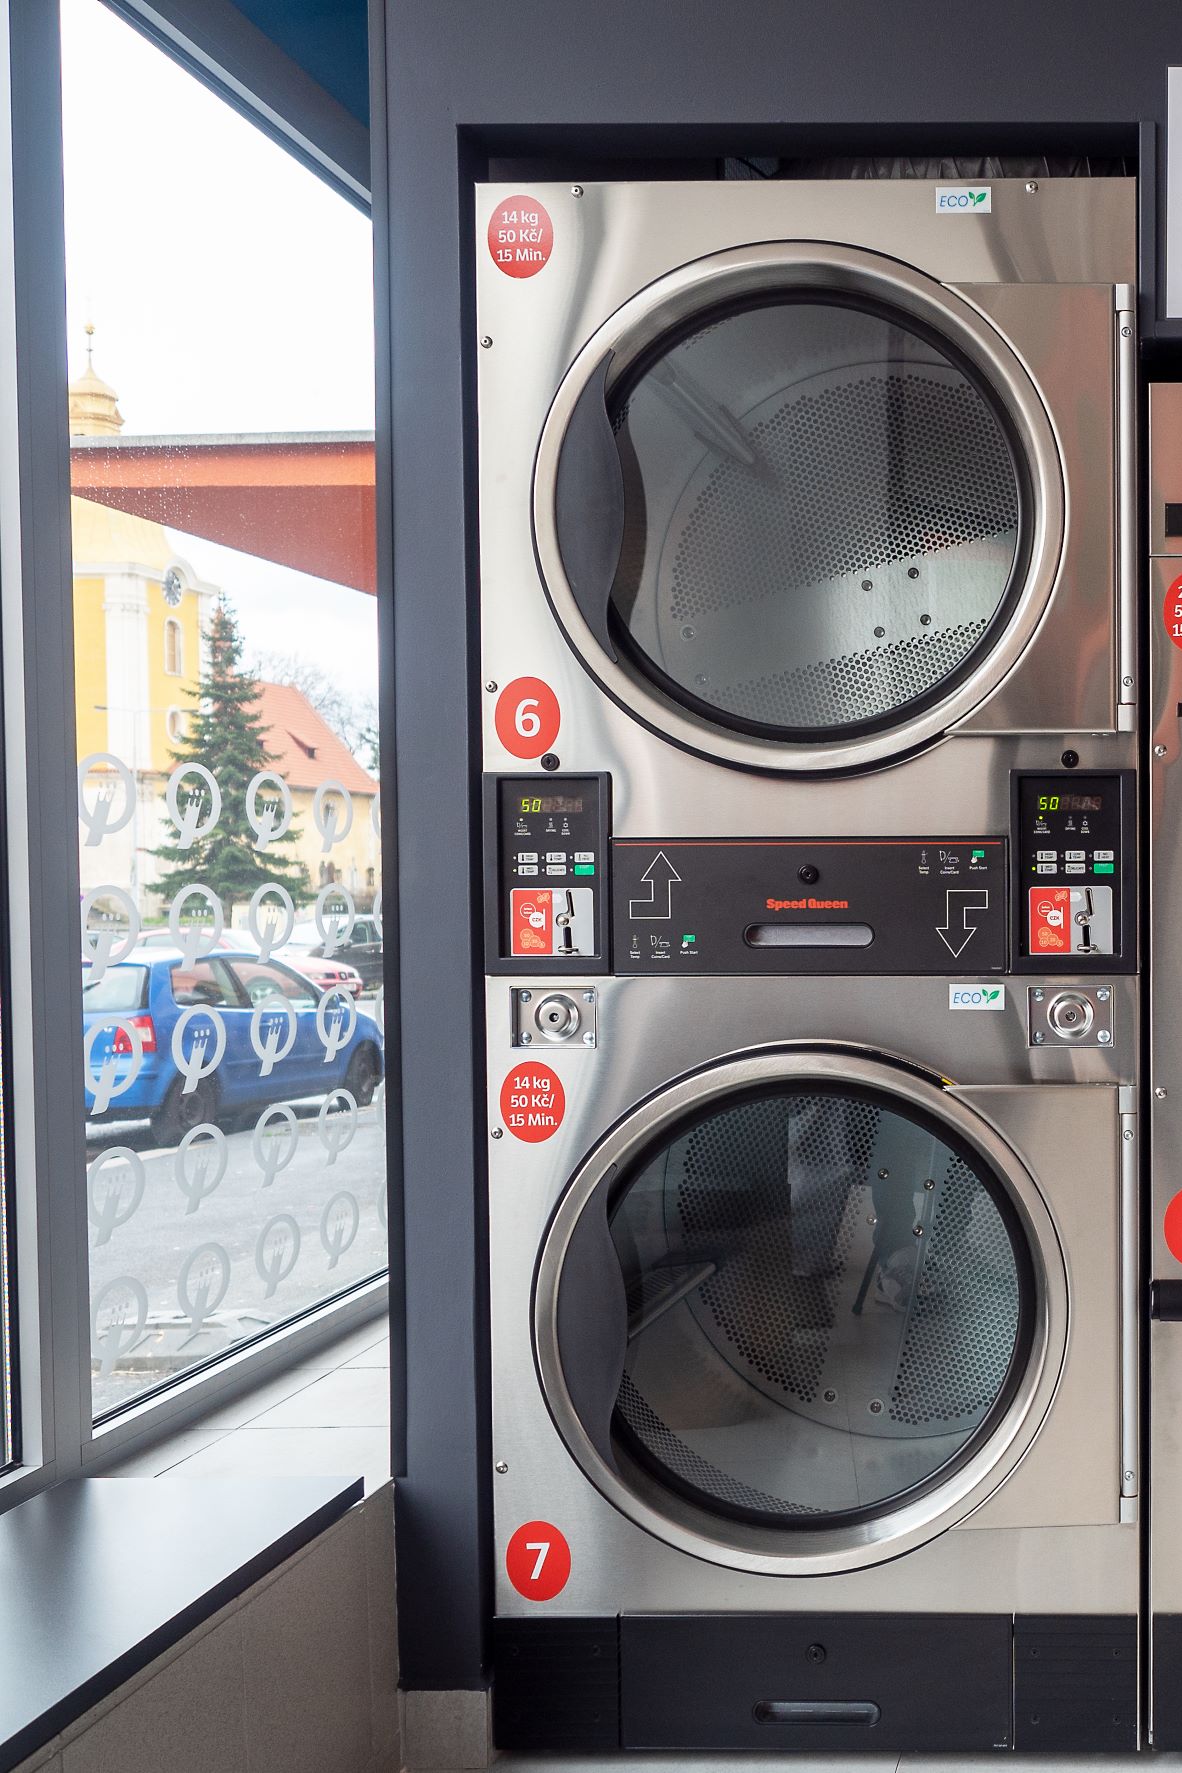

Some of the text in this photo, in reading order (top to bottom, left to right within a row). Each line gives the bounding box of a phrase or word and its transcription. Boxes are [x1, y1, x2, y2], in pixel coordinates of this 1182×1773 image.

[939, 194, 968, 208] ECO
[502, 210, 538, 226] 14 kg
[498, 228, 543, 243] 50 Kč/
[496, 248, 546, 262] 15 Min.
[515, 698, 540, 738] 6
[521, 798, 542, 812] 50
[1039, 796, 1060, 810] 50
[766, 898, 848, 911] Speed Queen
[952, 992, 981, 1004] ECO
[514, 1076, 550, 1092] 14 kg
[511, 1094, 555, 1108] 50 Kč/
[508, 1112, 558, 1126] 15 Min.
[526, 1542, 550, 1580] 7
